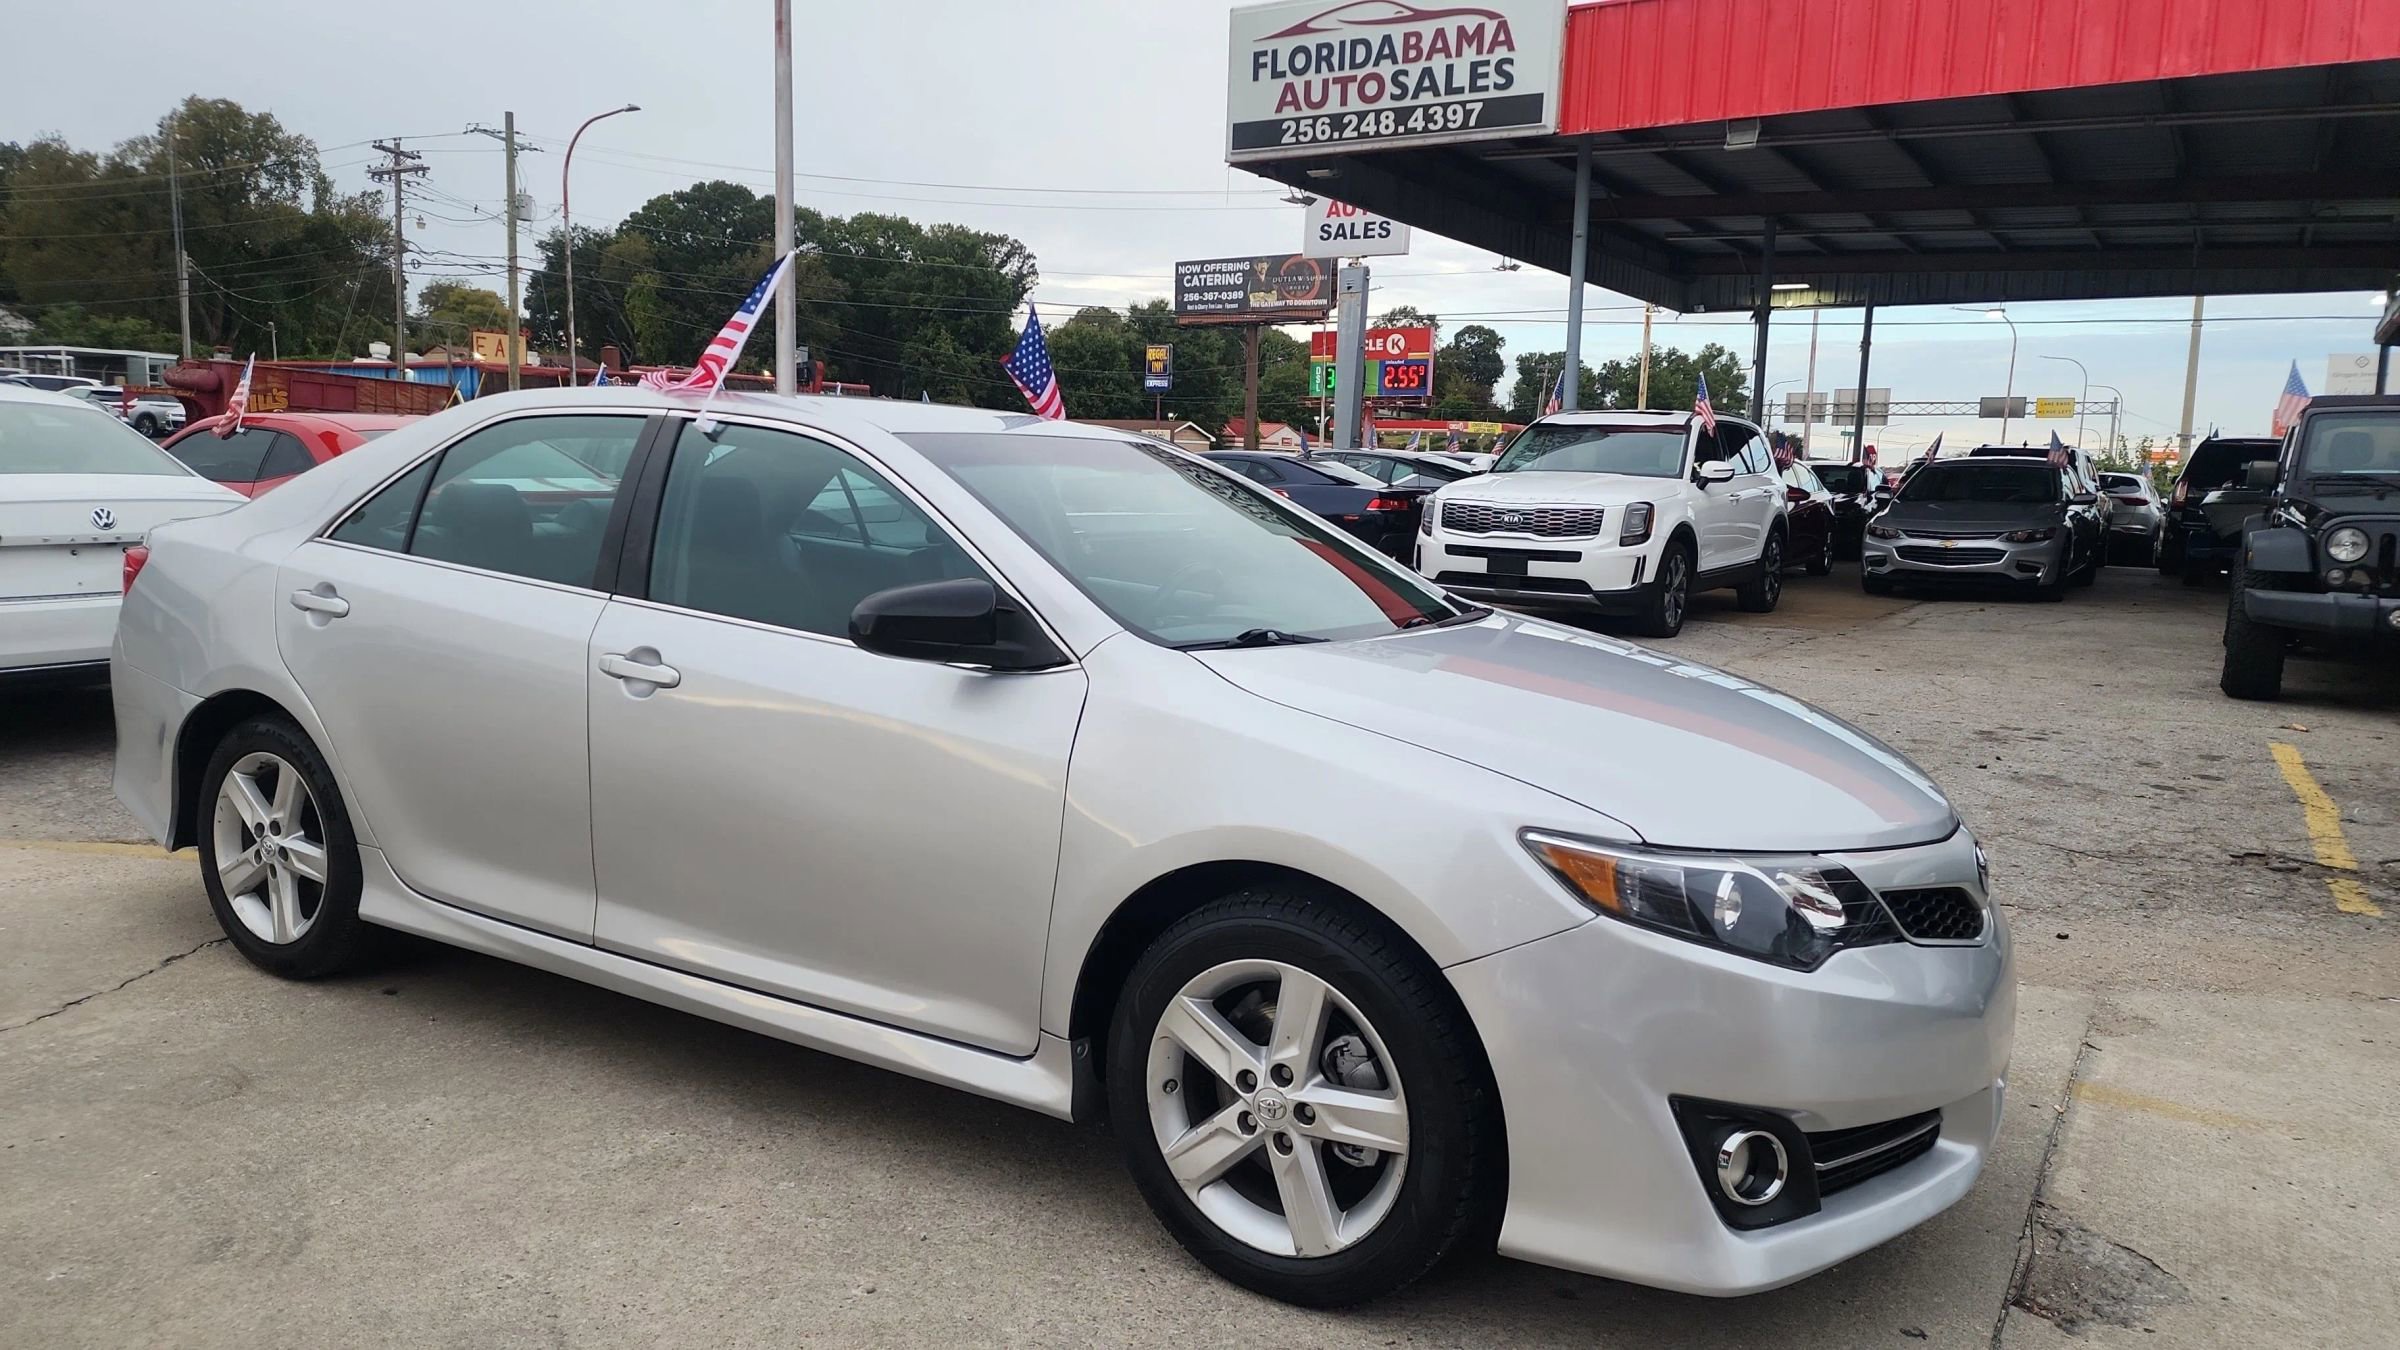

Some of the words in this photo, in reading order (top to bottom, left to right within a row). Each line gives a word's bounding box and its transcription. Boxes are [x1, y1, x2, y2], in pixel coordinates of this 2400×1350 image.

[1280, 102, 1484, 145] 256.248.4397
[1327, 200, 1368, 218] AU
[1319, 221, 1391, 241] SALES
[1178, 264, 1201, 275] NOW
[1203, 261, 1250, 273] OFFERING
[1183, 272, 1244, 287] CATERING
[1183, 290, 1244, 302] 256-367-0389
[475, 336, 506, 358] EA
[1148, 348, 1168, 360] REGAL
[1151, 360, 1164, 373] INN
[1146, 379, 1169, 387] EXPRESS
[250, 387, 289, 412] ILL'S
